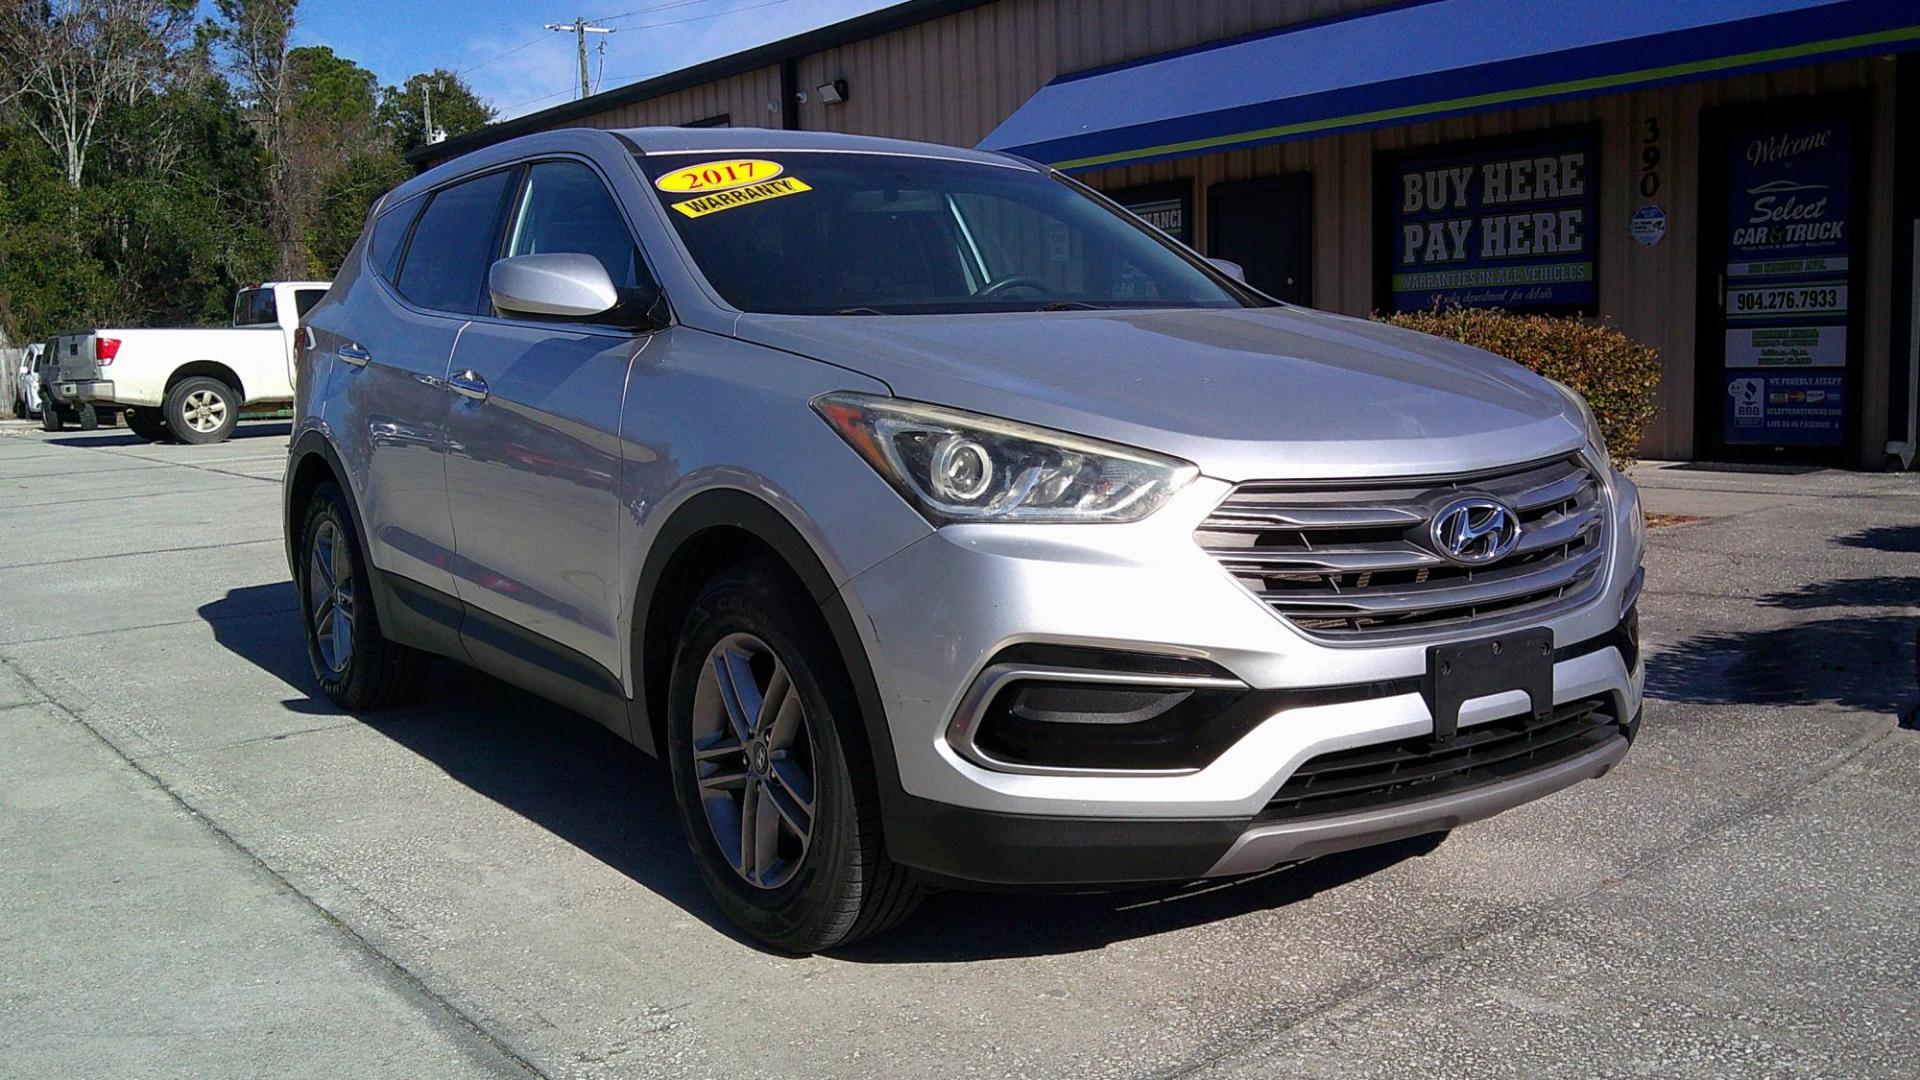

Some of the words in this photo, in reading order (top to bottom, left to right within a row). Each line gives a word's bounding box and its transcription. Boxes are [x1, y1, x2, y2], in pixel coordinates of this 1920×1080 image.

[1640, 117, 1660, 198] 390
[1746, 130, 1832, 168] Welcome
[682, 161, 755, 190] 2017
[1402, 166, 1474, 213] BUY
[1482, 152, 1585, 204] HERE
[685, 179, 795, 214] WARRANTY
[1749, 196, 1828, 224] Select
[1402, 219, 1473, 264] PAY
[1480, 209, 1584, 258] HERE
[1732, 227, 1768, 246] CAR
[1785, 221, 1845, 242] TRUCK
[1401, 272, 1475, 289] WARRANTIES
[1479, 271, 1494, 285] ON
[1496, 269, 1521, 283] ALL
[1524, 265, 1585, 282] VEHICLES
[1737, 289, 1837, 311] 904.276.7933
[1781, 377, 1815, 386] PROUDLY
[1815, 377, 1842, 386] ACCEPT
